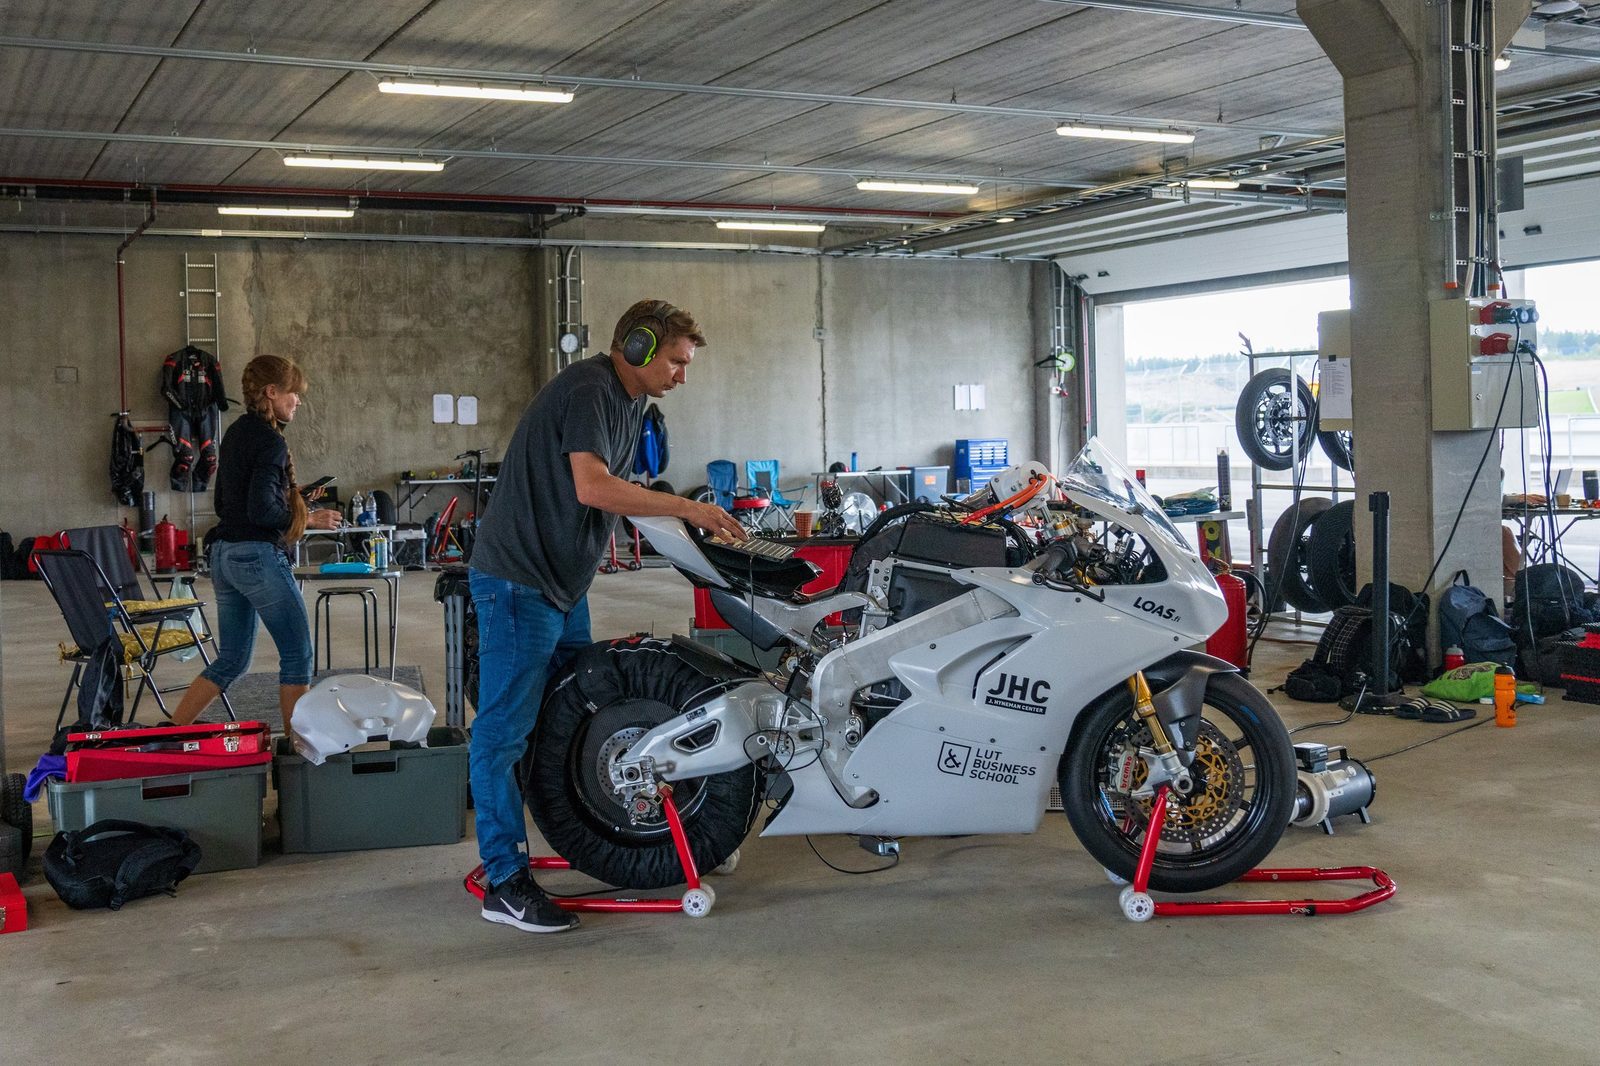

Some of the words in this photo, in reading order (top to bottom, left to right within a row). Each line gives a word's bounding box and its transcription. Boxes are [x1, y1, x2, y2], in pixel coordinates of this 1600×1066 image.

[987, 672, 1051, 704] JHC
[1021, 704, 1044, 714] CENTER
[976, 748, 1003, 761] LUT
[972, 758, 1037, 776] BUSINESS
[1120, 755, 1132, 789] brembo
[969, 769, 1020, 785] SCHOOL
